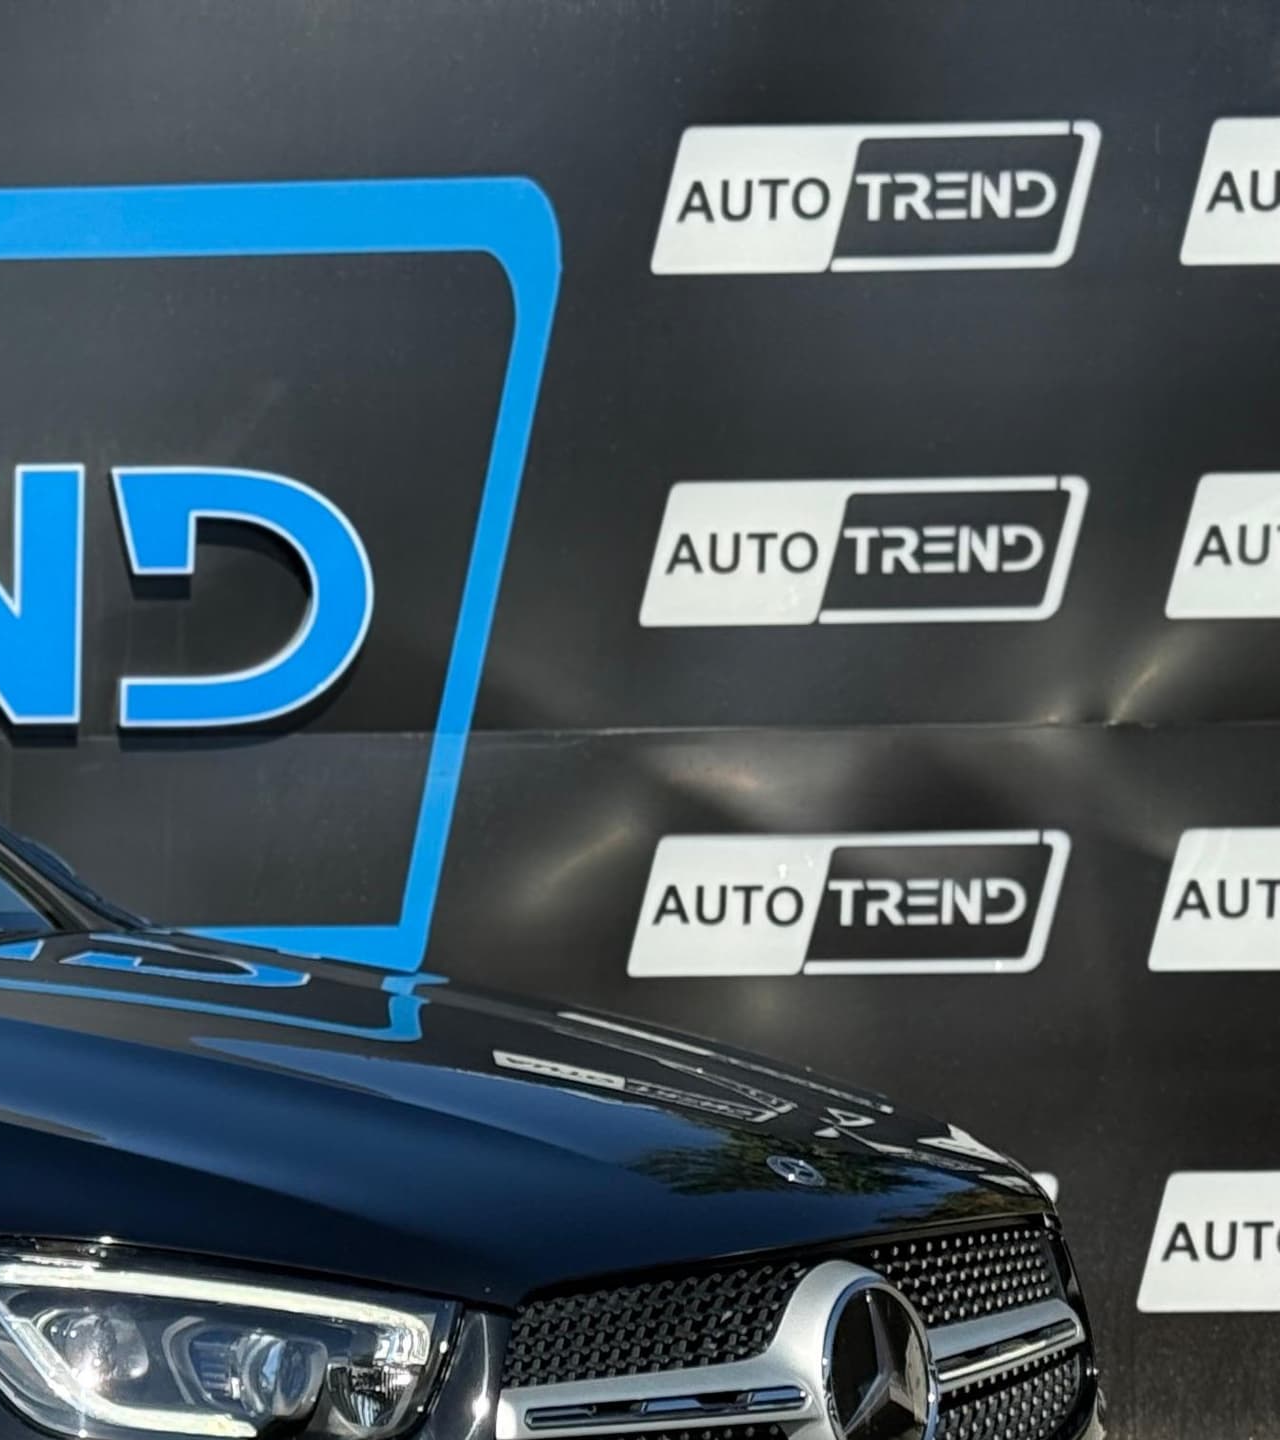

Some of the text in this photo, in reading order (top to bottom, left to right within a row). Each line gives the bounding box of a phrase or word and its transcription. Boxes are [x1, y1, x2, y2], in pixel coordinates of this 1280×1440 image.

[676, 170, 1057, 223] AUTO TREND
[665, 525, 1044, 575] AUTO TREND
[1194, 523, 1280, 566] AU
[651, 878, 1027, 926] AUTO TREND
[1162, 1220, 1280, 1262] AUT
